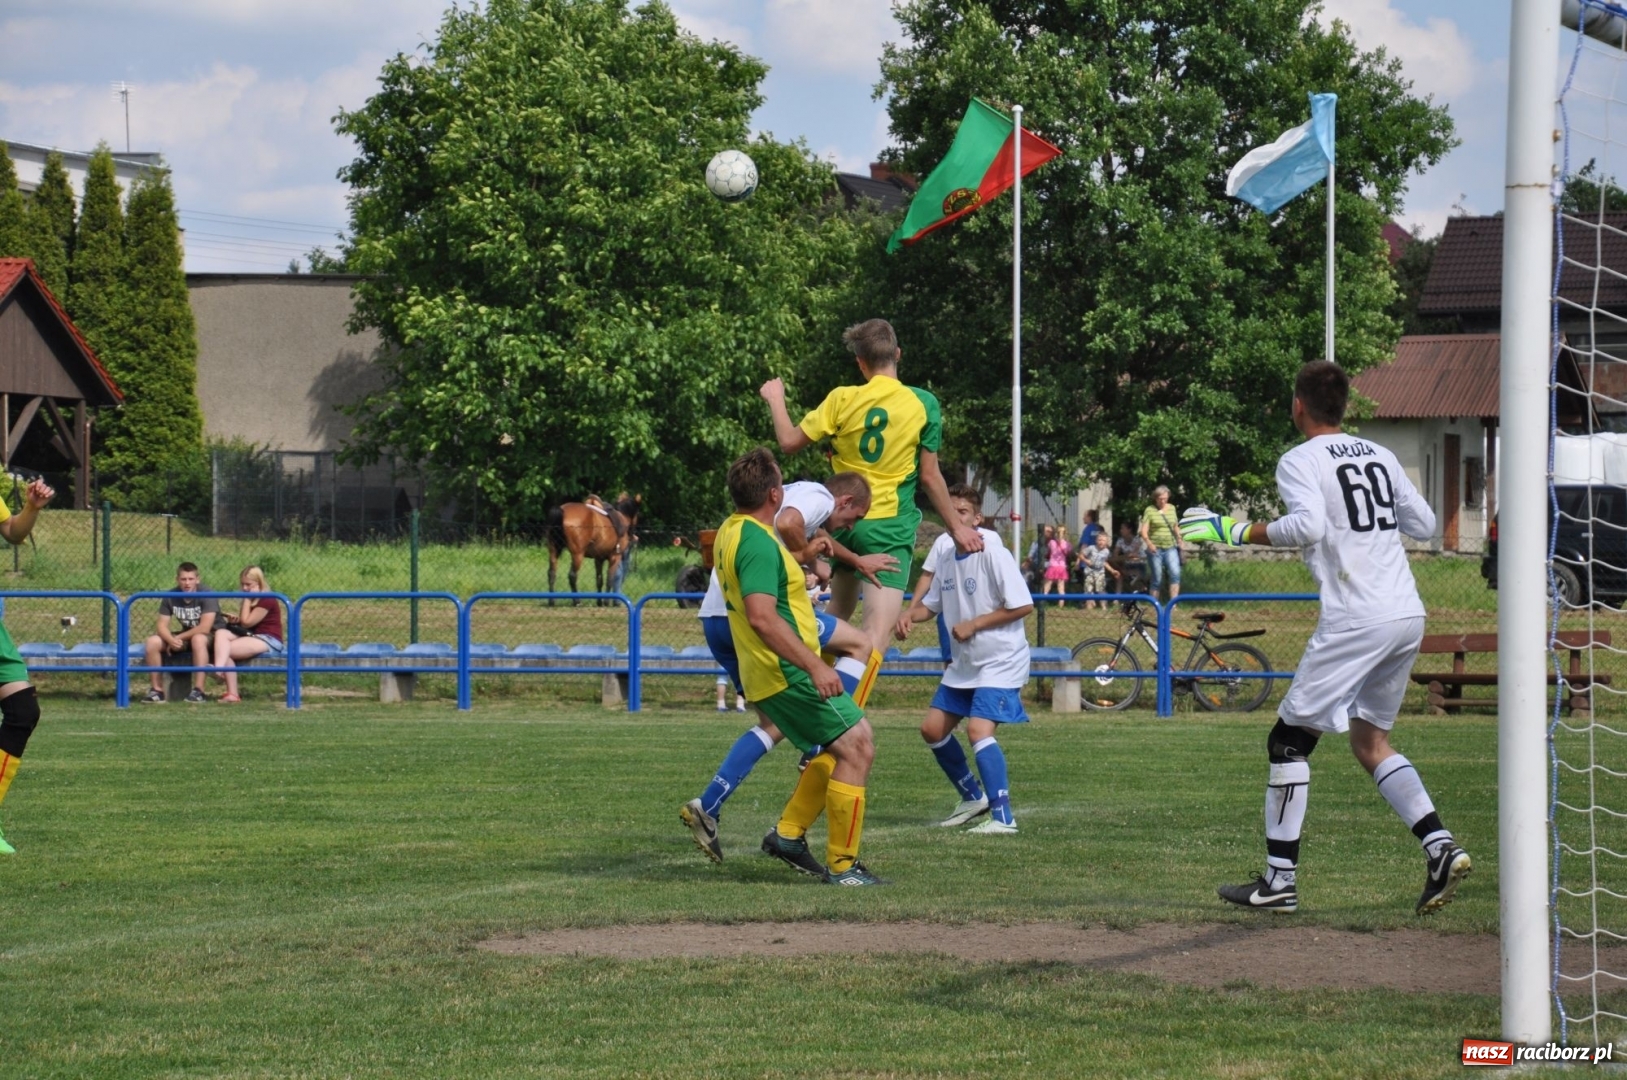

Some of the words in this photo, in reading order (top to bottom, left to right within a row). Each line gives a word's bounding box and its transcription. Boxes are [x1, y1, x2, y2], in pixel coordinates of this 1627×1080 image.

[859, 407, 889, 464] 8
[1325, 439, 1377, 460] KAŁUŻA
[1336, 461, 1398, 532] 69
